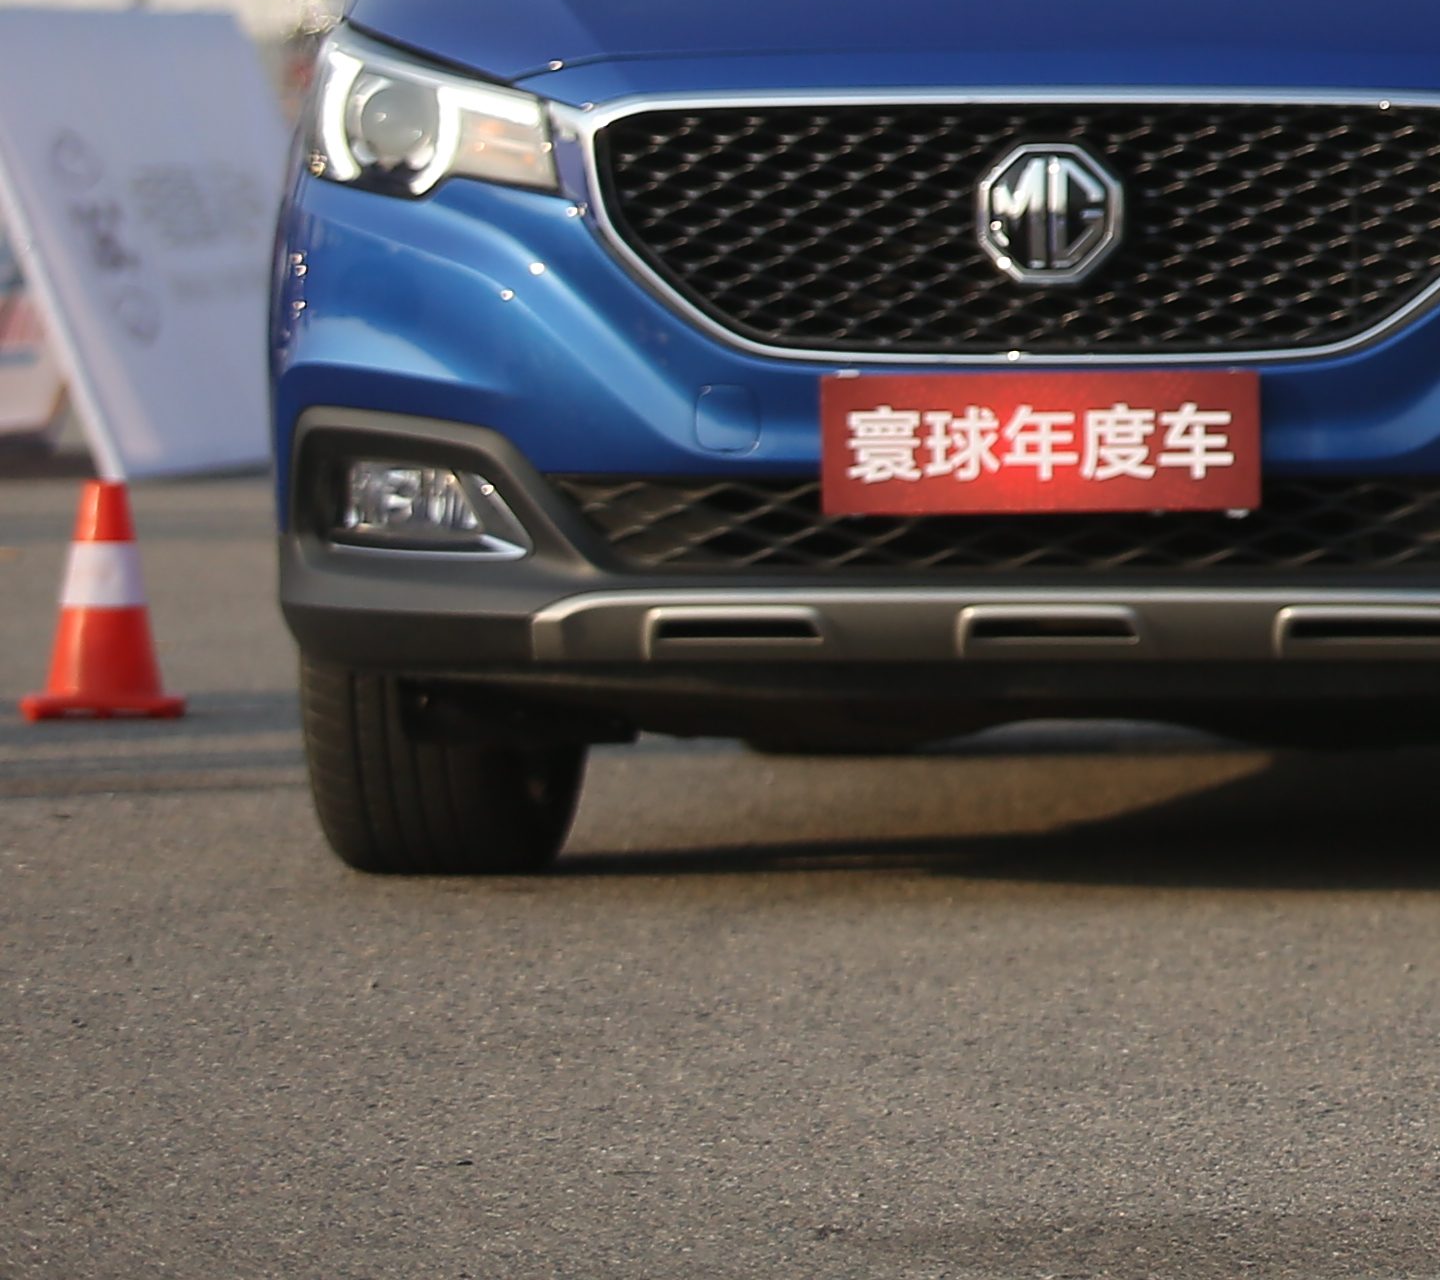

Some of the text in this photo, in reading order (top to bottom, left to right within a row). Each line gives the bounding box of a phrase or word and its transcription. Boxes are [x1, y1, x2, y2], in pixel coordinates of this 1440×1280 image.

[990, 156, 1106, 269] MG
[846, 402, 1235, 483] 寰球年度车
